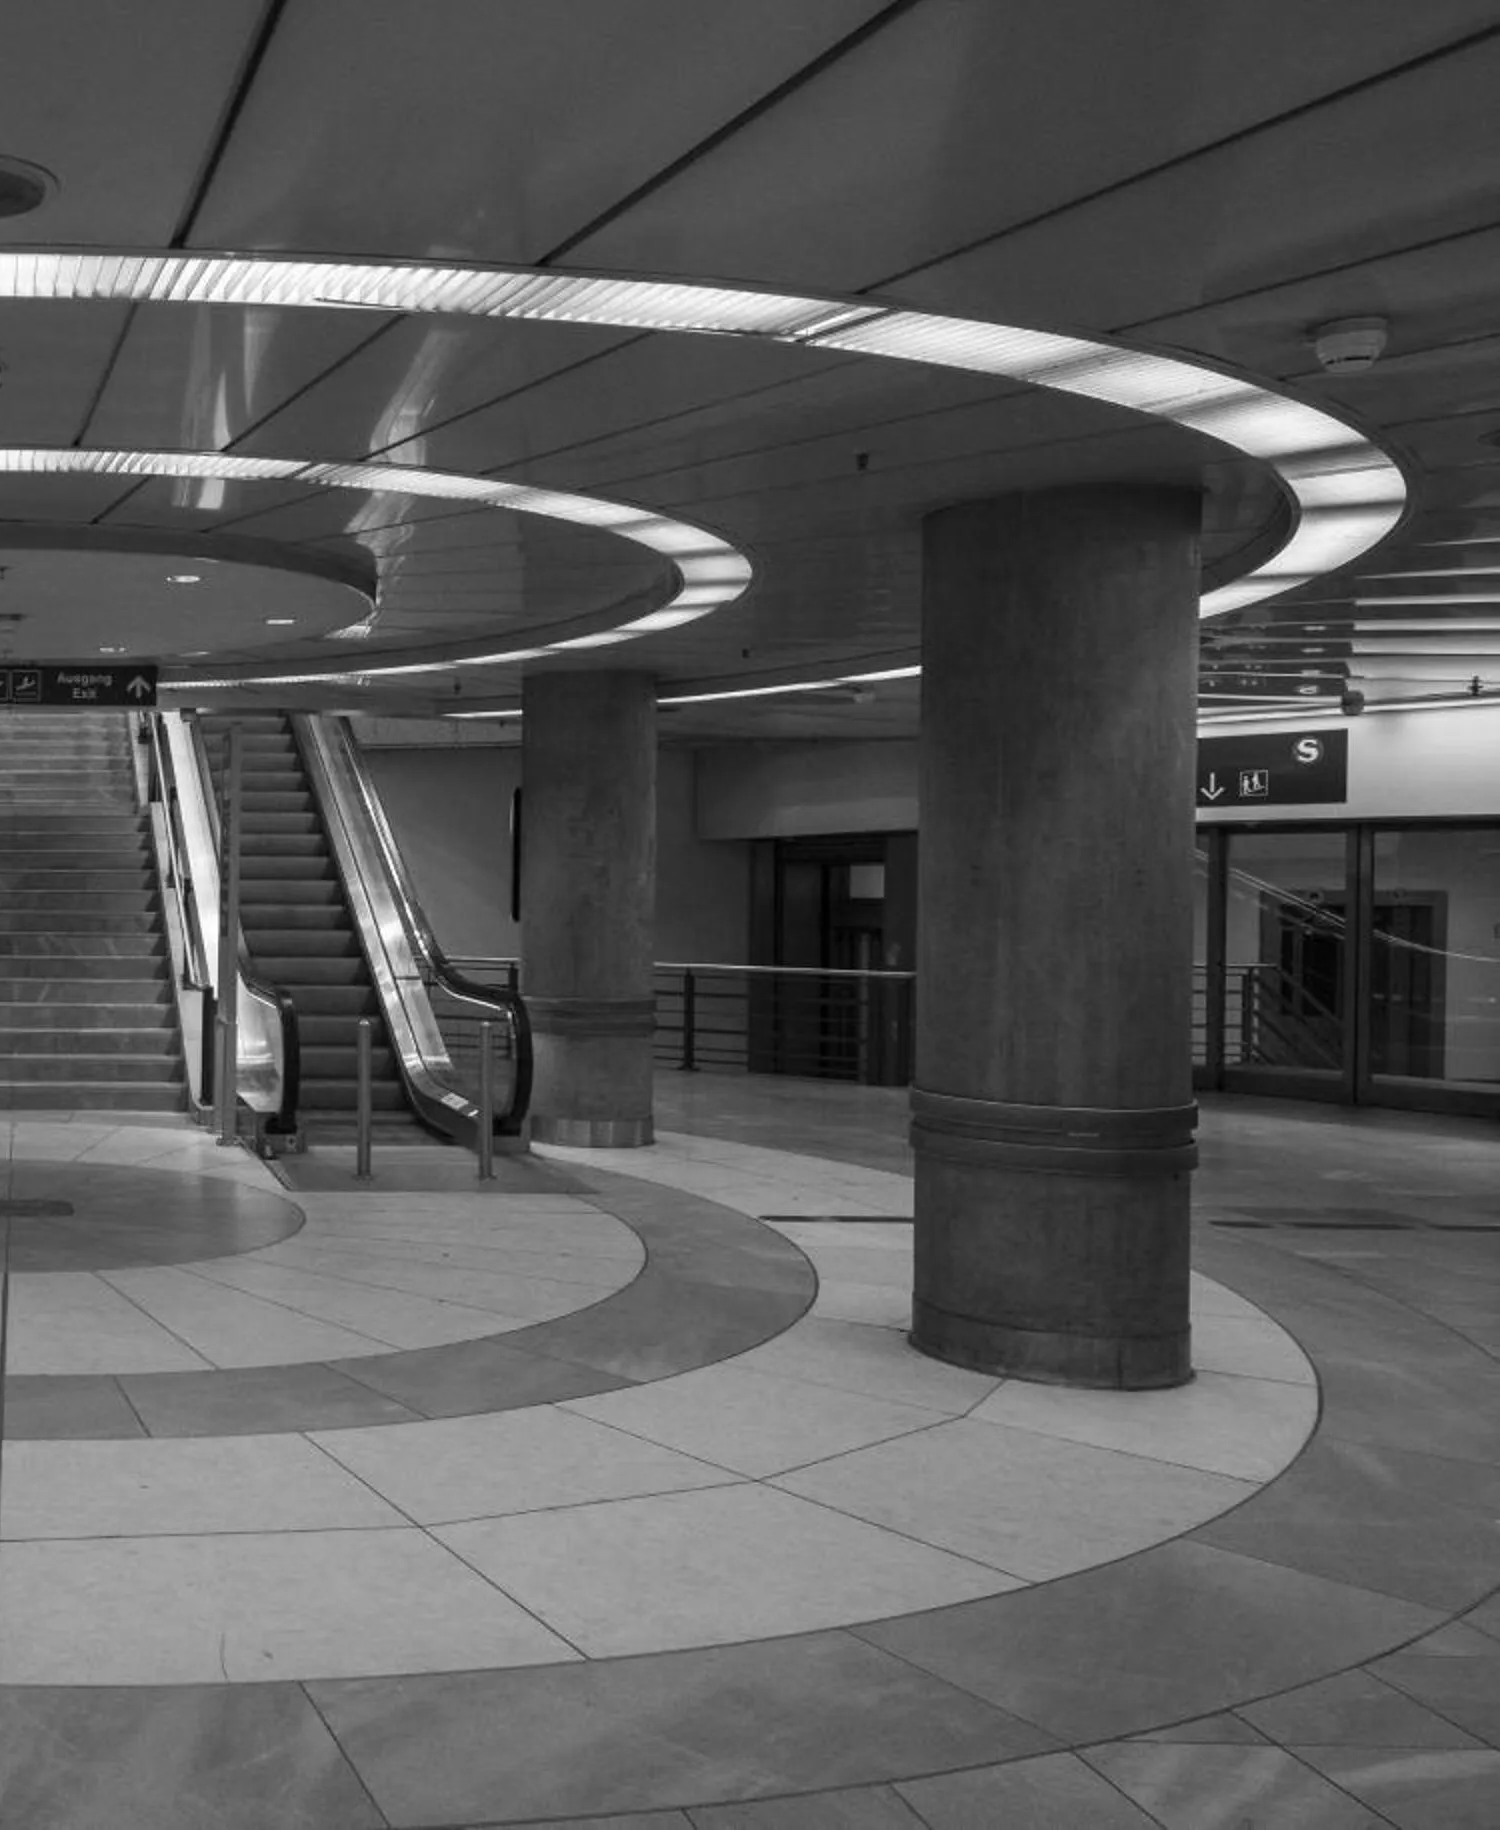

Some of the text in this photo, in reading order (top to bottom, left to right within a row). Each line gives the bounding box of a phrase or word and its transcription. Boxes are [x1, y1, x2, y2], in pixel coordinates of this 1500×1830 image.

[57, 672, 113, 687] Ausgang
[72, 687, 97, 699] Exit
[1297, 738, 1320, 763] S
